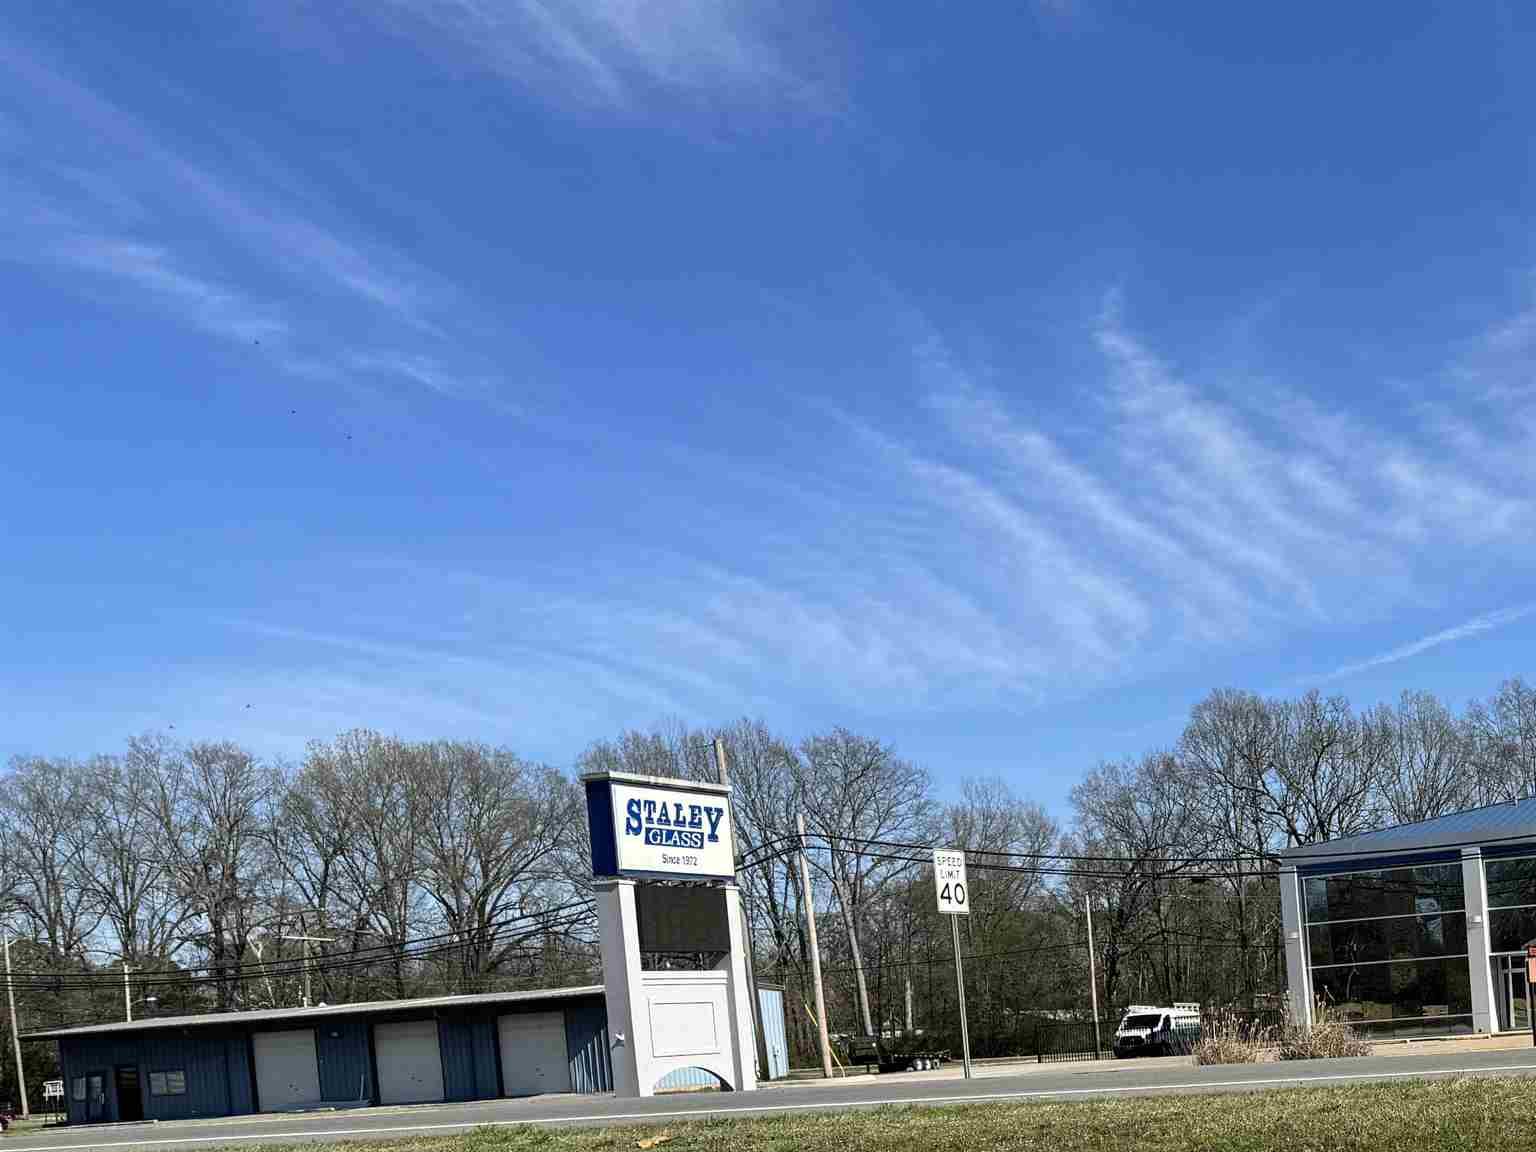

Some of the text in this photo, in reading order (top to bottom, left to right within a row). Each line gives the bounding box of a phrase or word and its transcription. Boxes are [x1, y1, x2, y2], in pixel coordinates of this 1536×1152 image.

[625, 798, 724, 843] STALEY
[648, 829, 702, 847] GLASS
[661, 853, 680, 865] Since
[940, 869, 961, 880] LIMIT
[940, 882, 966, 905] 40
